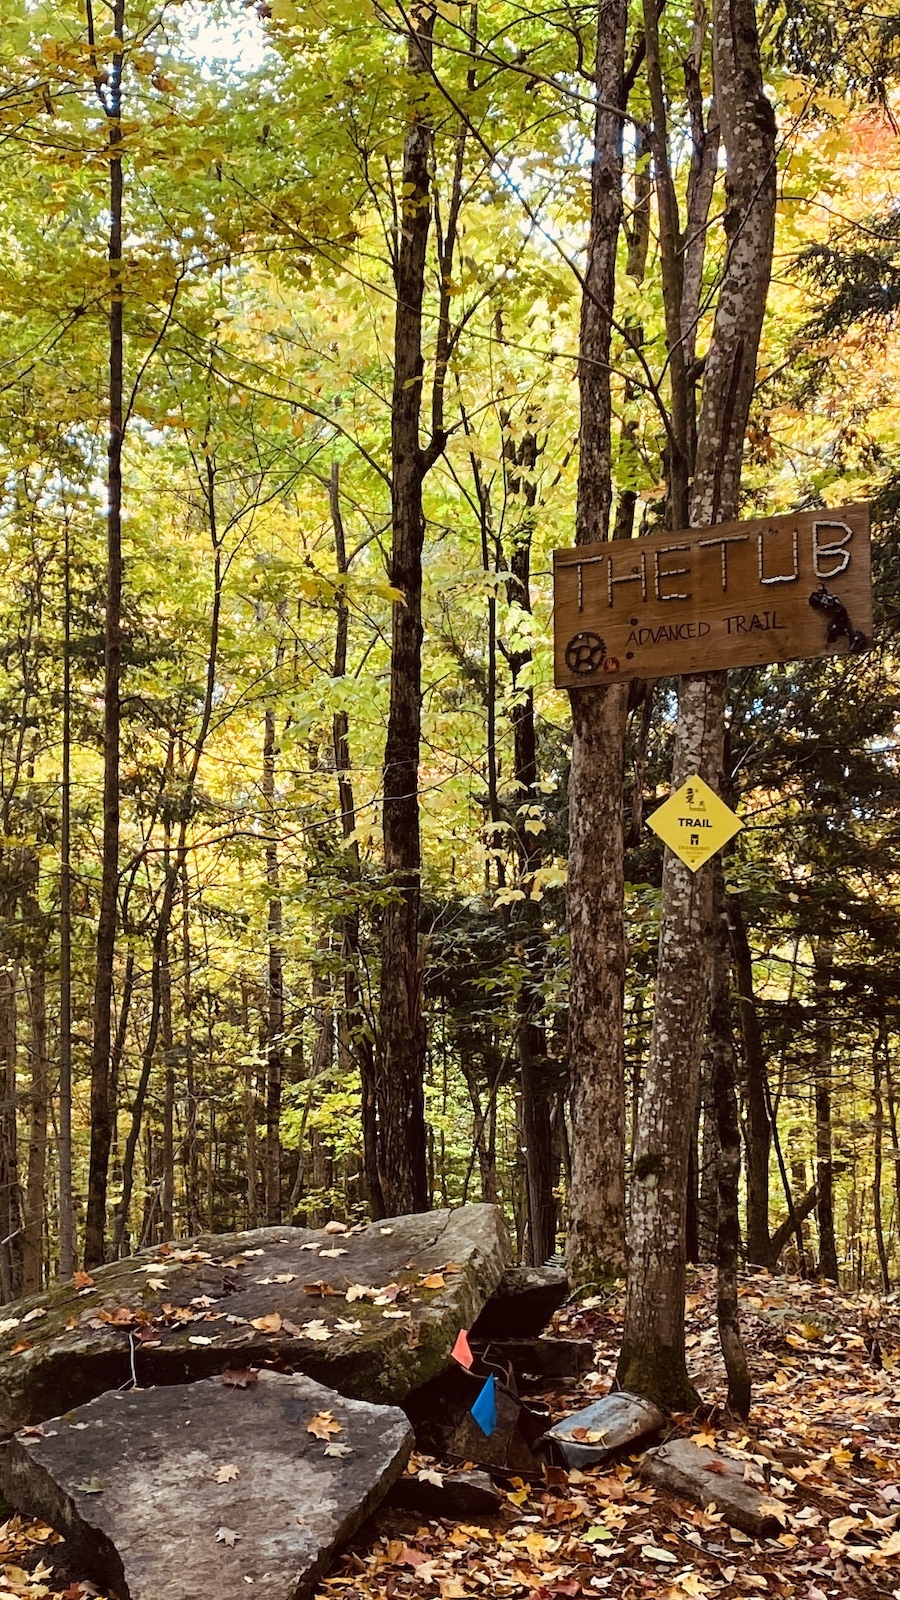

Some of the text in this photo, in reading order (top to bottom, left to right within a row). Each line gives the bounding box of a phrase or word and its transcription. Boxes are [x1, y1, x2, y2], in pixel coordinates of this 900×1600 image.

[555, 520, 853, 612] THE TUB
[625, 611, 787, 647] ADVANCED TRAIL
[678, 818, 713, 828] TRAIL
